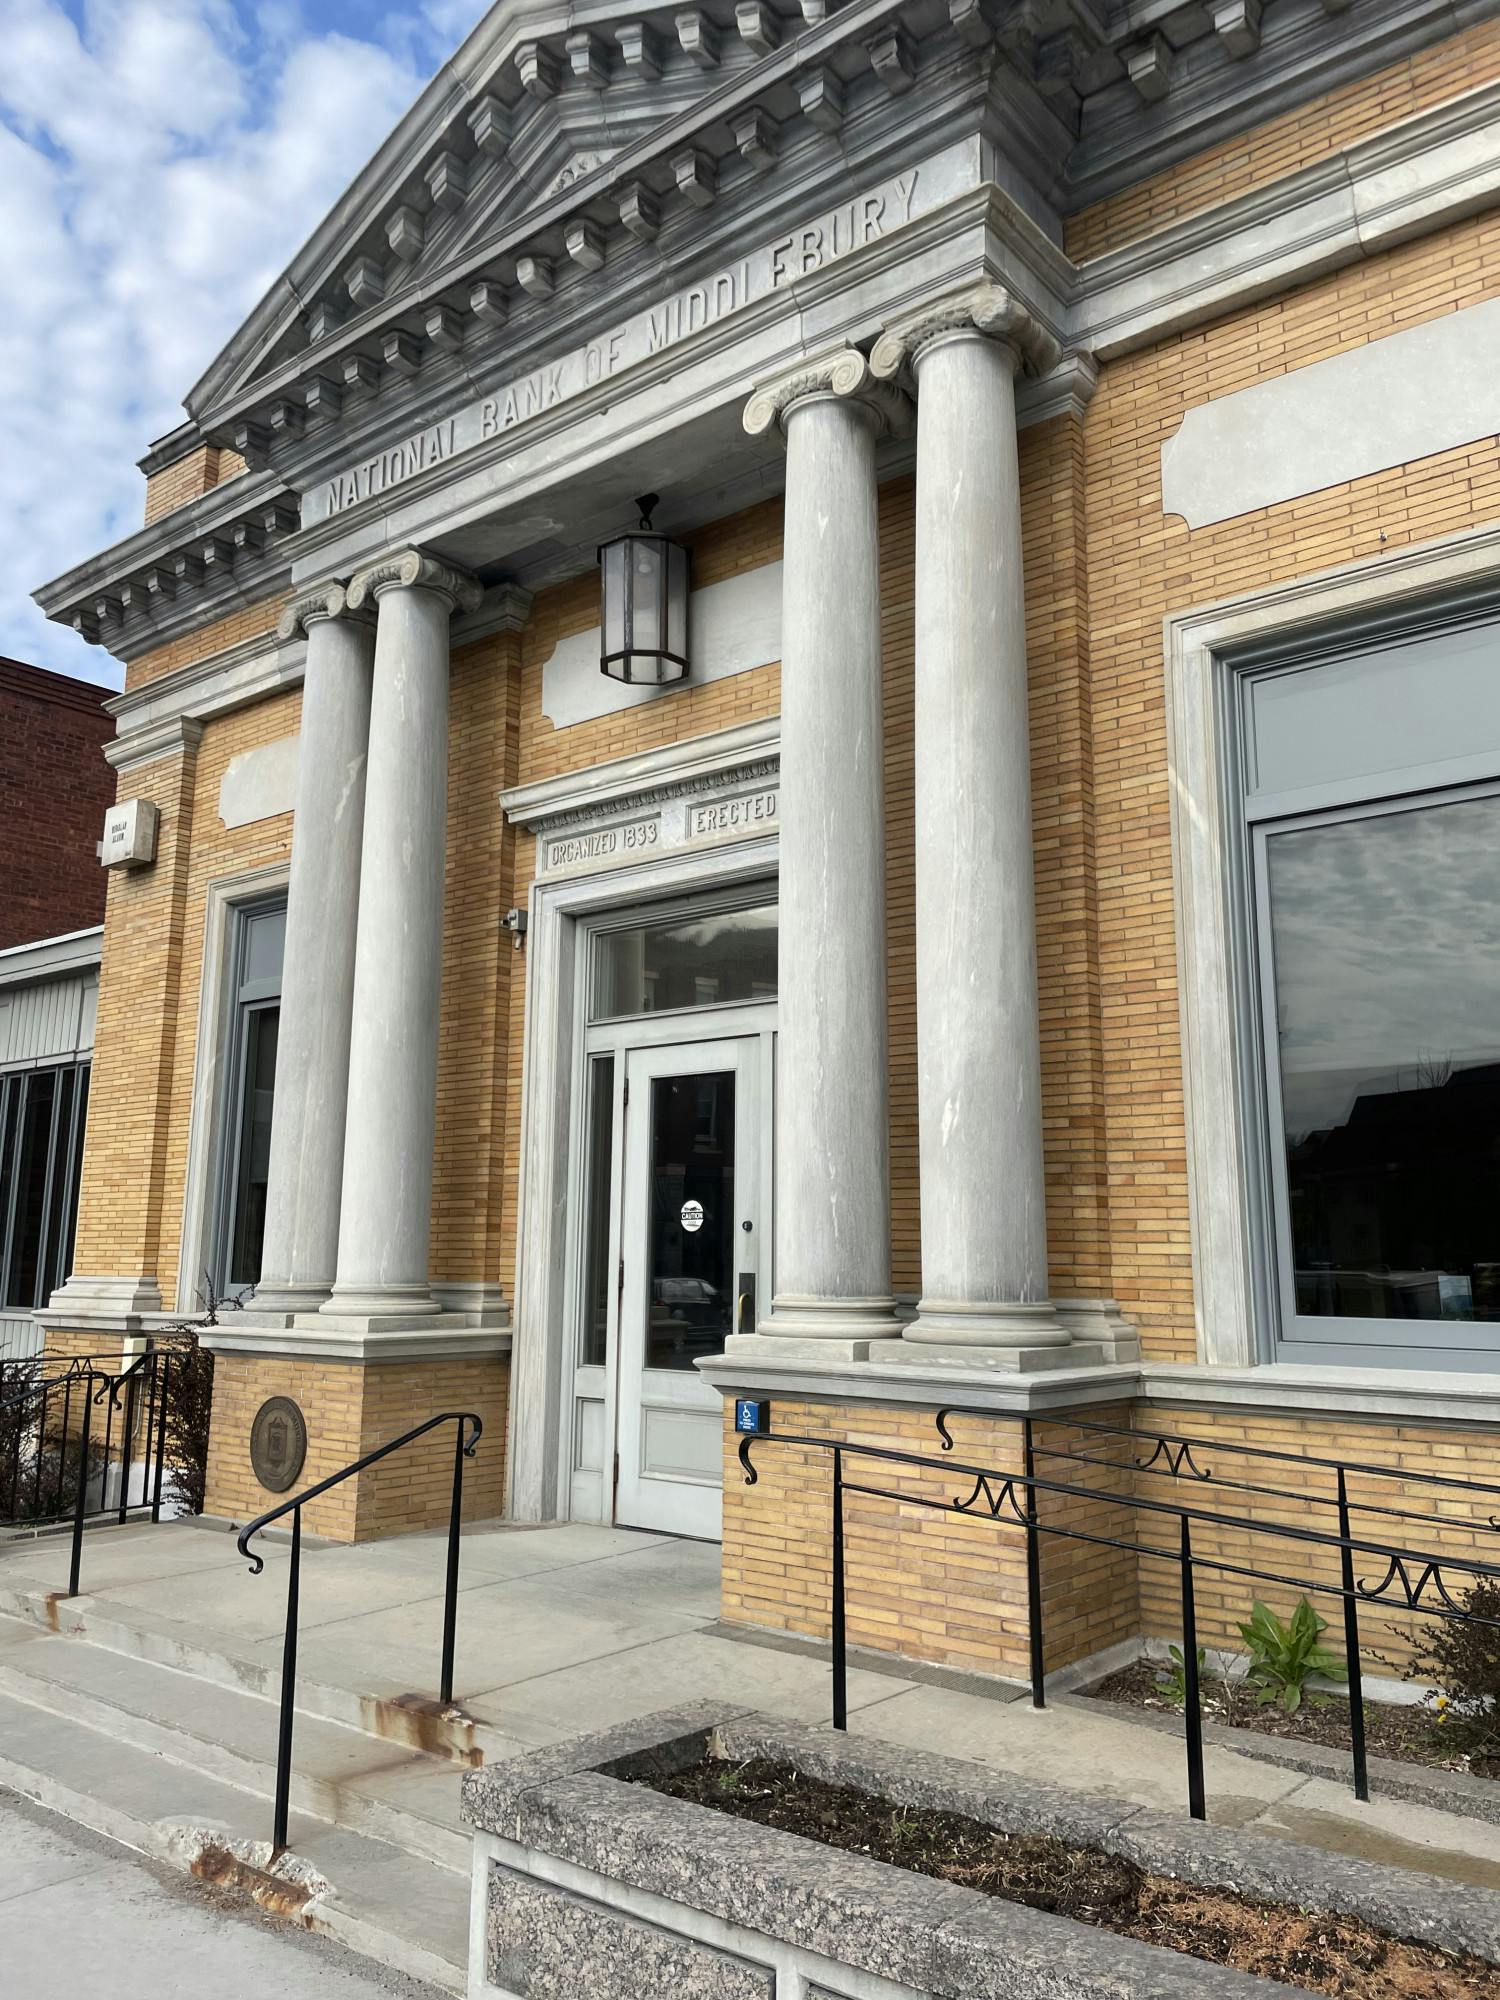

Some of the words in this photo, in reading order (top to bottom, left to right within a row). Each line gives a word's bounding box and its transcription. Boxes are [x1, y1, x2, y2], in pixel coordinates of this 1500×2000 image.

[327, 419, 455, 516] NATIONAL
[482, 365, 565, 439] BANK
[583, 328, 627, 387] OF
[649, 170, 920, 353] MIDDLEBURY
[696, 793, 777, 833] ERECTED
[551, 832, 617, 866] ORGANIZED
[622, 822, 658, 849] 1833
